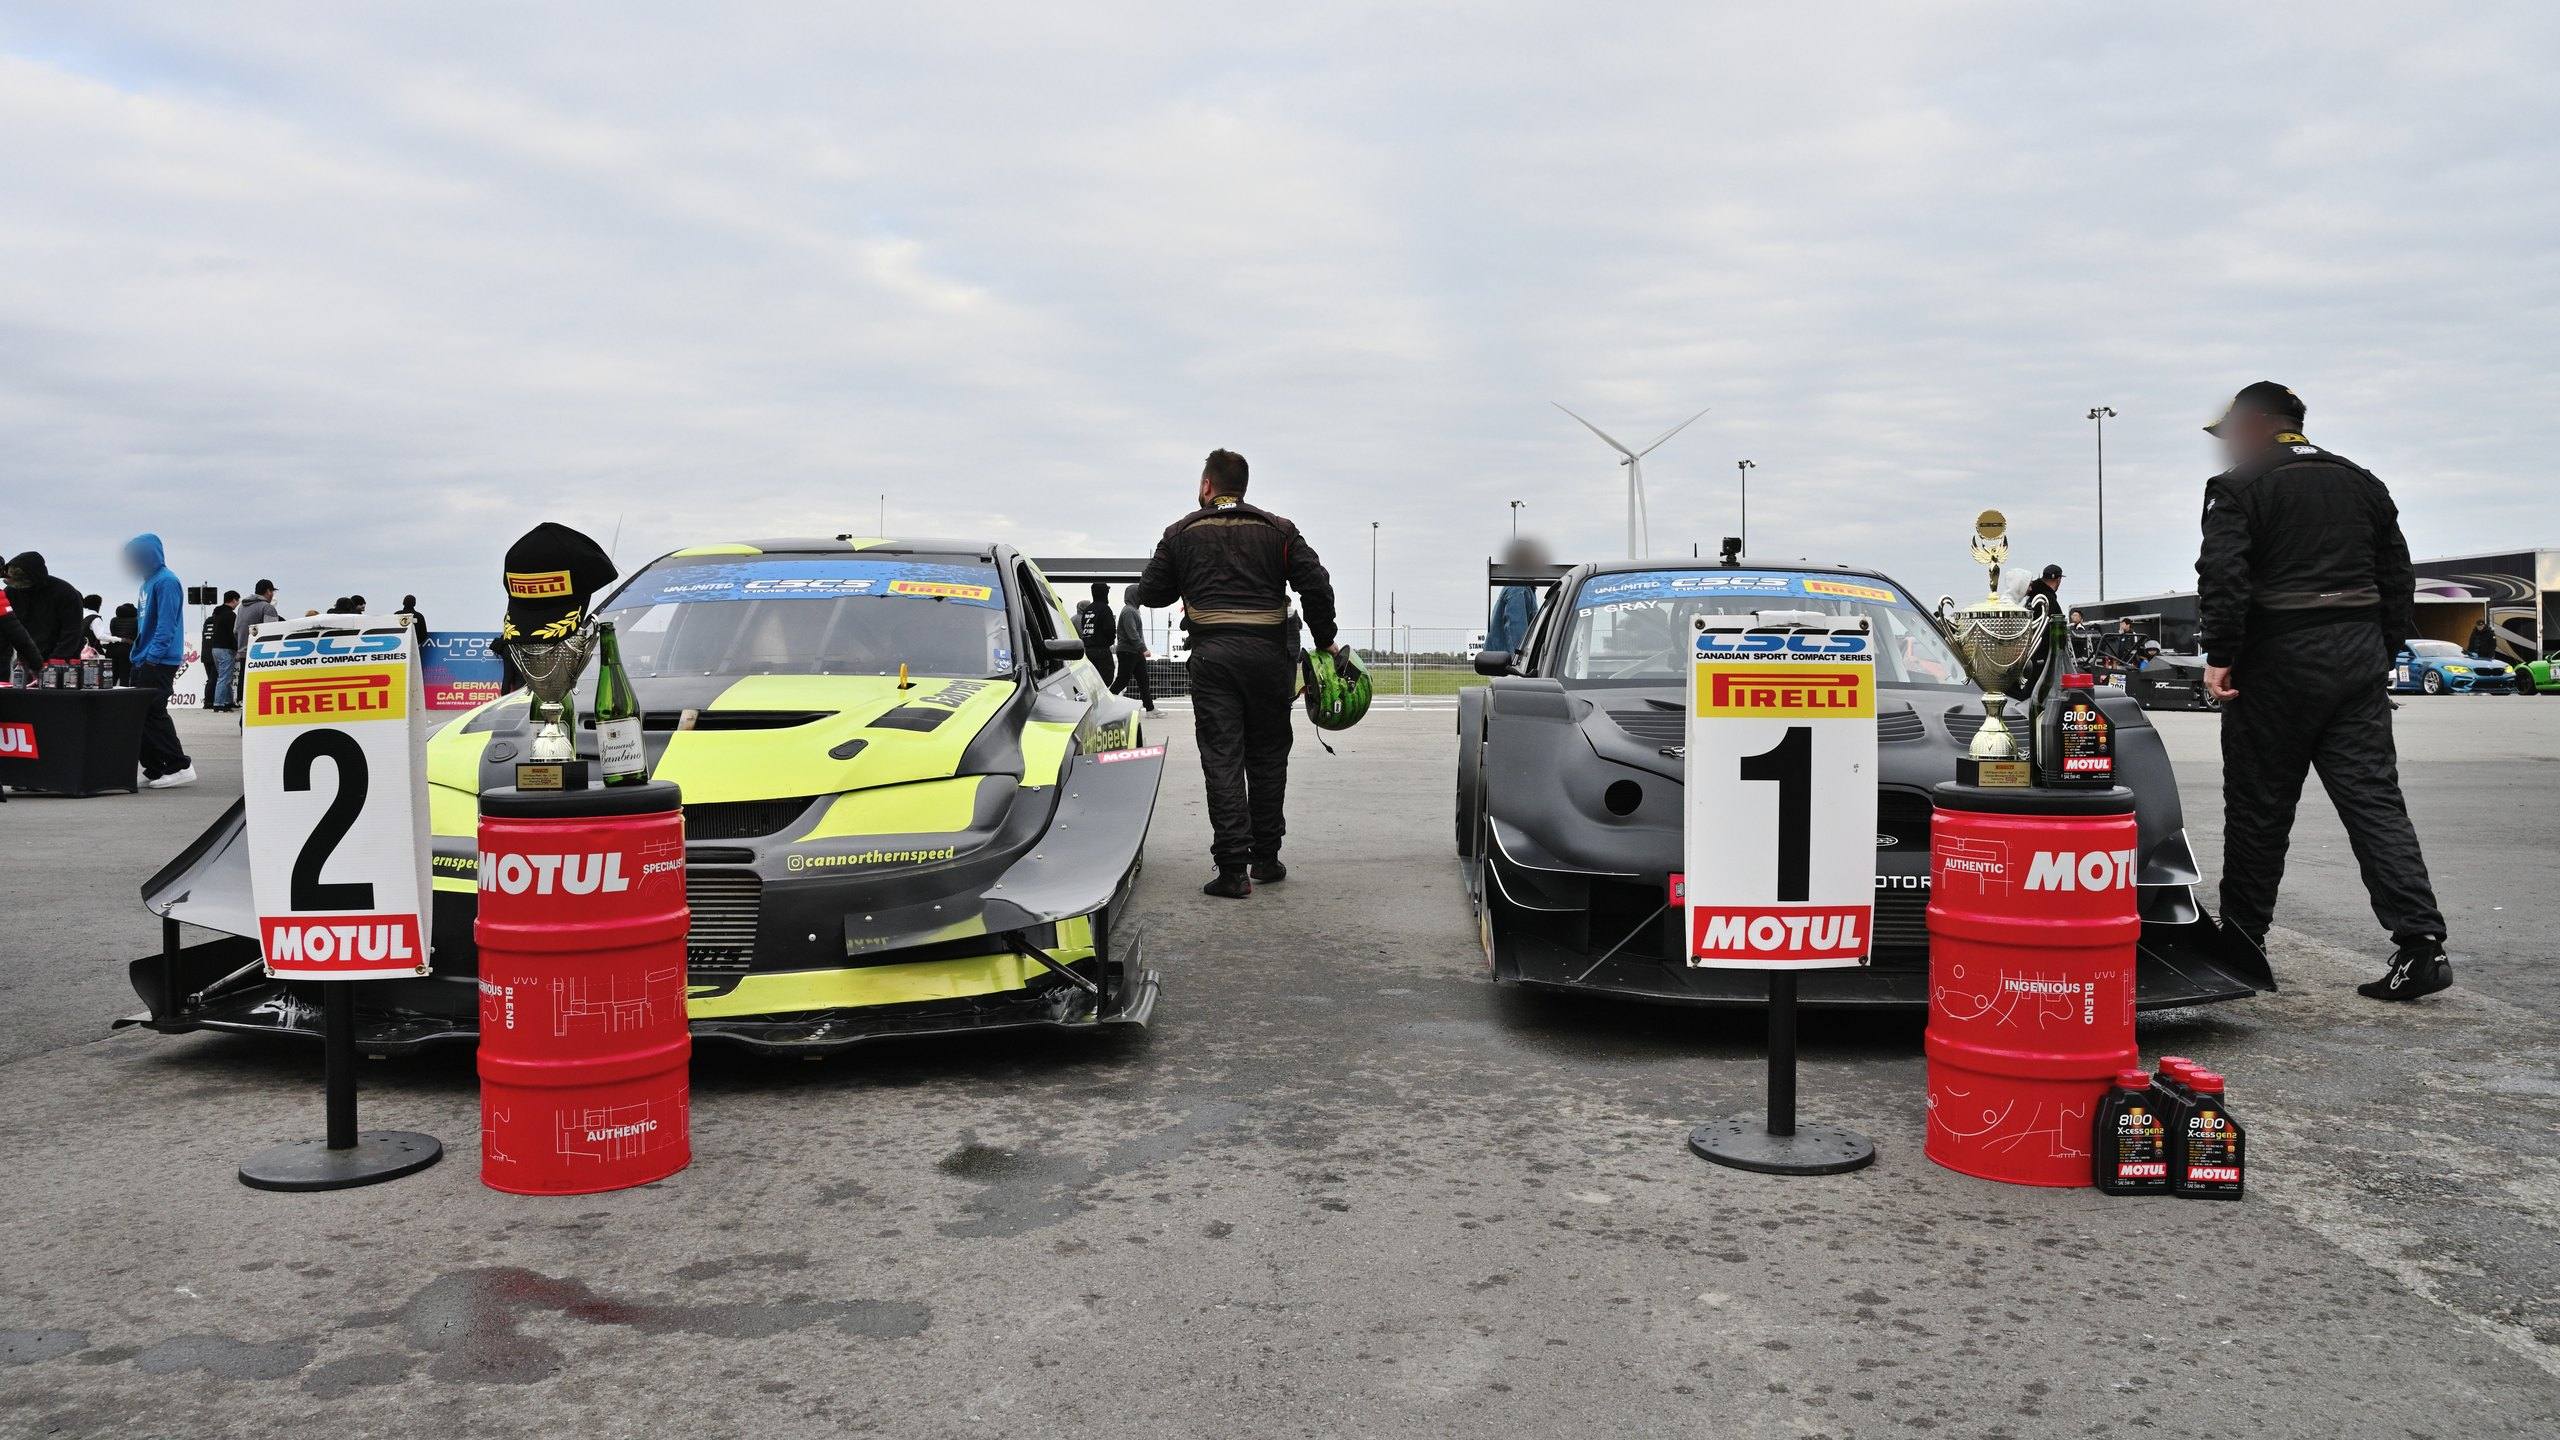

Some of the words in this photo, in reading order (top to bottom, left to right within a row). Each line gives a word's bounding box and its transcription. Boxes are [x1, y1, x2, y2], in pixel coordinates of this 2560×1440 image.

[509, 575, 565, 594] PIRELLI
[664, 583, 735, 593] UNLIMITED
[744, 579, 876, 589] CSCS
[1594, 581, 1661, 594] UNLIMITED
[1671, 577, 1792, 588] CSCS
[1811, 582, 1888, 600] PIRELLI
[1579, 607, 1598, 618] B.
[1604, 600, 1658, 612] GRAY
[249, 627, 408, 660] CSCS
[1696, 628, 1870, 652] CSCS
[248, 659, 288, 668] CANADIAN
[290, 657, 318, 666] SPORT
[321, 655, 367, 664] COMPACT
[371, 652, 407, 661] SERIES
[1696, 652, 1750, 660] CANADIAN
[1791, 653, 1836, 661] COMPACT
[1839, 654, 1872, 662] SERIES
[453, 682, 502, 690] GERMA
[1712, 673, 1859, 708] PIRELLI
[258, 674, 391, 716] PIRELLI
[436, 692, 464, 701] CAR
[2063, 711, 2096, 721] 8100
[1103, 748, 1161, 761] MOTUL
[2066, 759, 2109, 769] MOTUL
[283, 728, 375, 911] 2
[1740, 726, 1812, 902] 1
[432, 856, 479, 871] ernspee
[805, 846, 955, 867] cannorthernspeed
[479, 852, 630, 895] MOTUL
[1945, 857, 2004, 874] AUTHENTIC
[2023, 848, 2137, 892] MOTU
[1875, 875, 1931, 889] OTOR
[1702, 915, 1862, 951] MOTUL
[272, 924, 412, 962] MOTUL
[2005, 979, 2081, 994] INGENIOUS
[505, 986, 514, 1030] BLEND
[2084, 982, 2095, 1025] BLEND
[2119, 1114, 2152, 1125] 8100
[2189, 1117, 2225, 1129] 8100
[586, 1119, 658, 1142] AUTHENTIC
[2120, 1164, 2165, 1176] MOTUL
[2190, 1168, 2237, 1180] MOTUL
